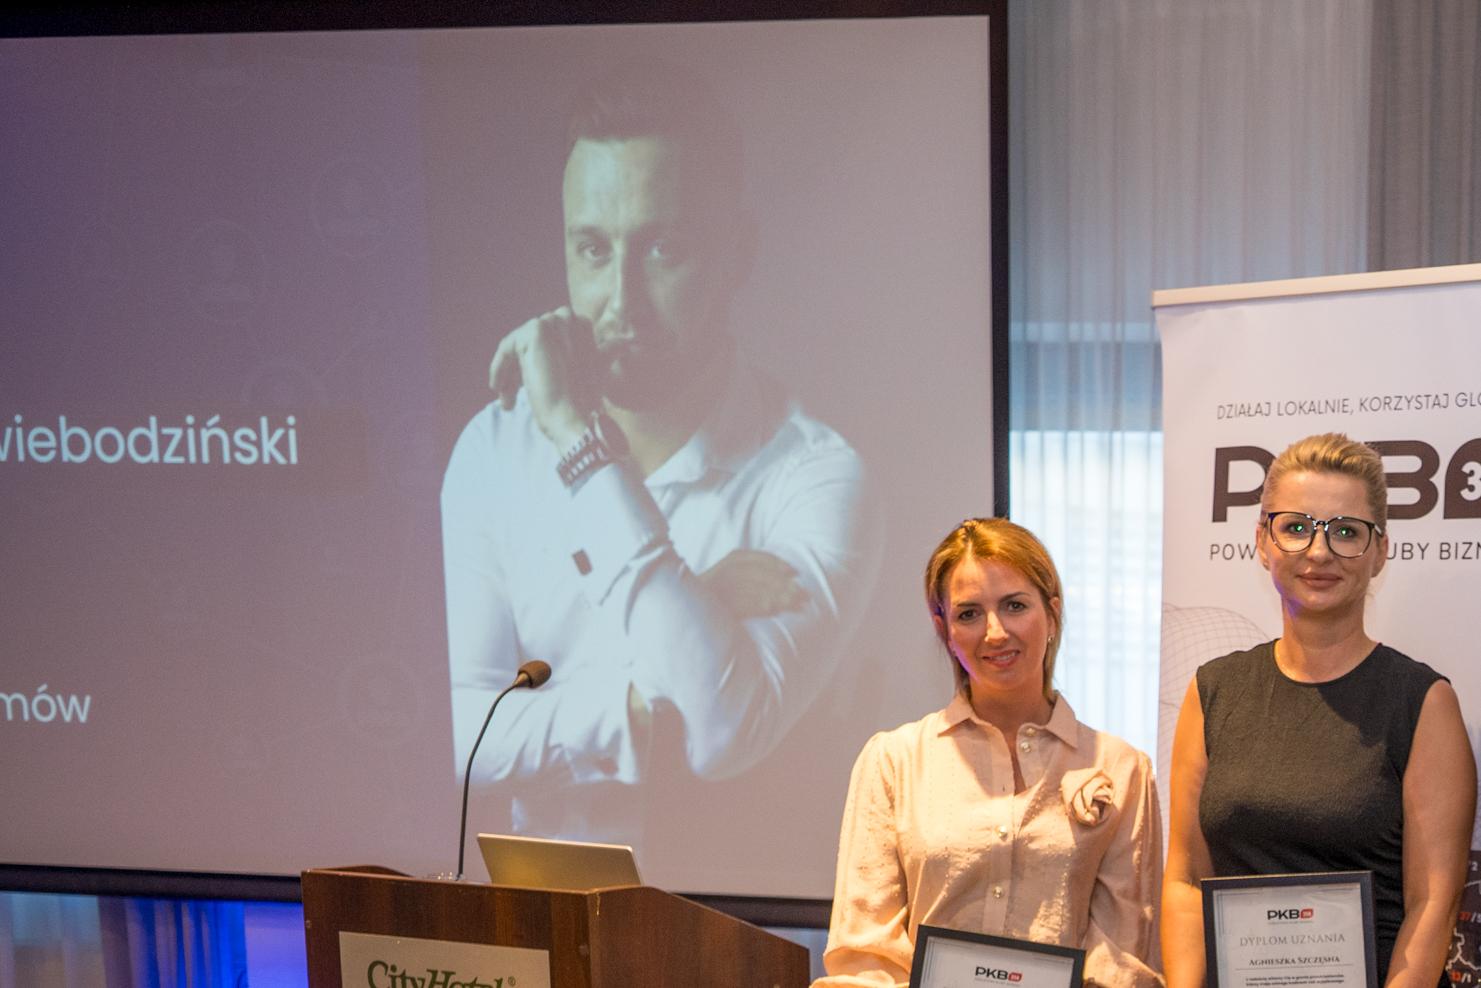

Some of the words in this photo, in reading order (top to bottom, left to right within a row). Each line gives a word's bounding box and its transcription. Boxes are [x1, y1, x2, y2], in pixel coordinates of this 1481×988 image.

[1217, 401, 1271, 420] DZIAŁAJ
[1277, 398, 1354, 416] LOKALNIE,
[1359, 393, 1449, 413] KORZYSTAJ
[1267, 909, 1300, 920] PKB
[1240, 936, 1288, 947] DYPLOM
[1291, 933, 1346, 945] UZNANIA
[975, 966, 1009, 981] PKB
